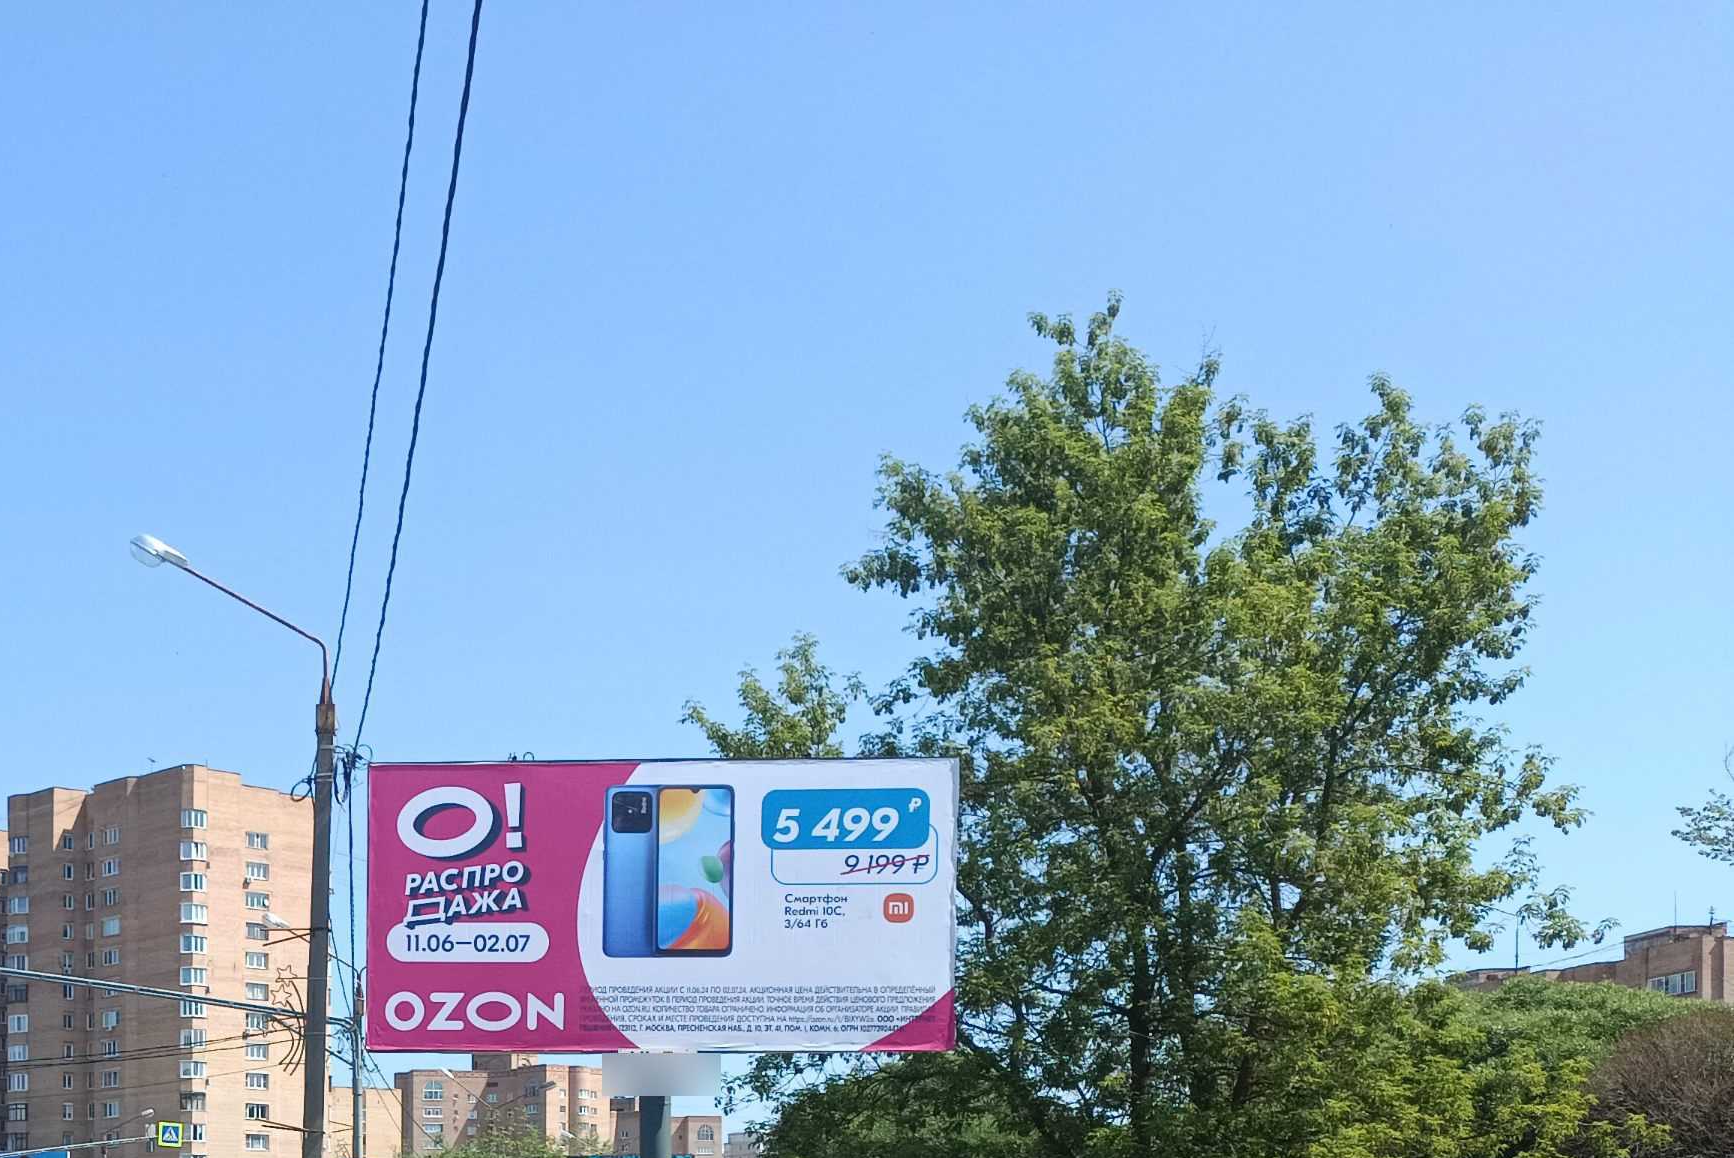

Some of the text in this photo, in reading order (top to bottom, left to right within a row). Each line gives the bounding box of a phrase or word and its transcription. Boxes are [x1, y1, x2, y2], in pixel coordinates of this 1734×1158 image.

[772, 808, 801, 843] 5
[811, 807, 900, 842] 499
[404, 860, 525, 896] РАСПРО
[403, 887, 524, 926] ДАЖА
[784, 893, 848, 905] Смартфон
[784, 906, 819, 916] Redmi
[784, 919, 828, 929] 3/64 Гб
[384, 991, 565, 1032] OZON
